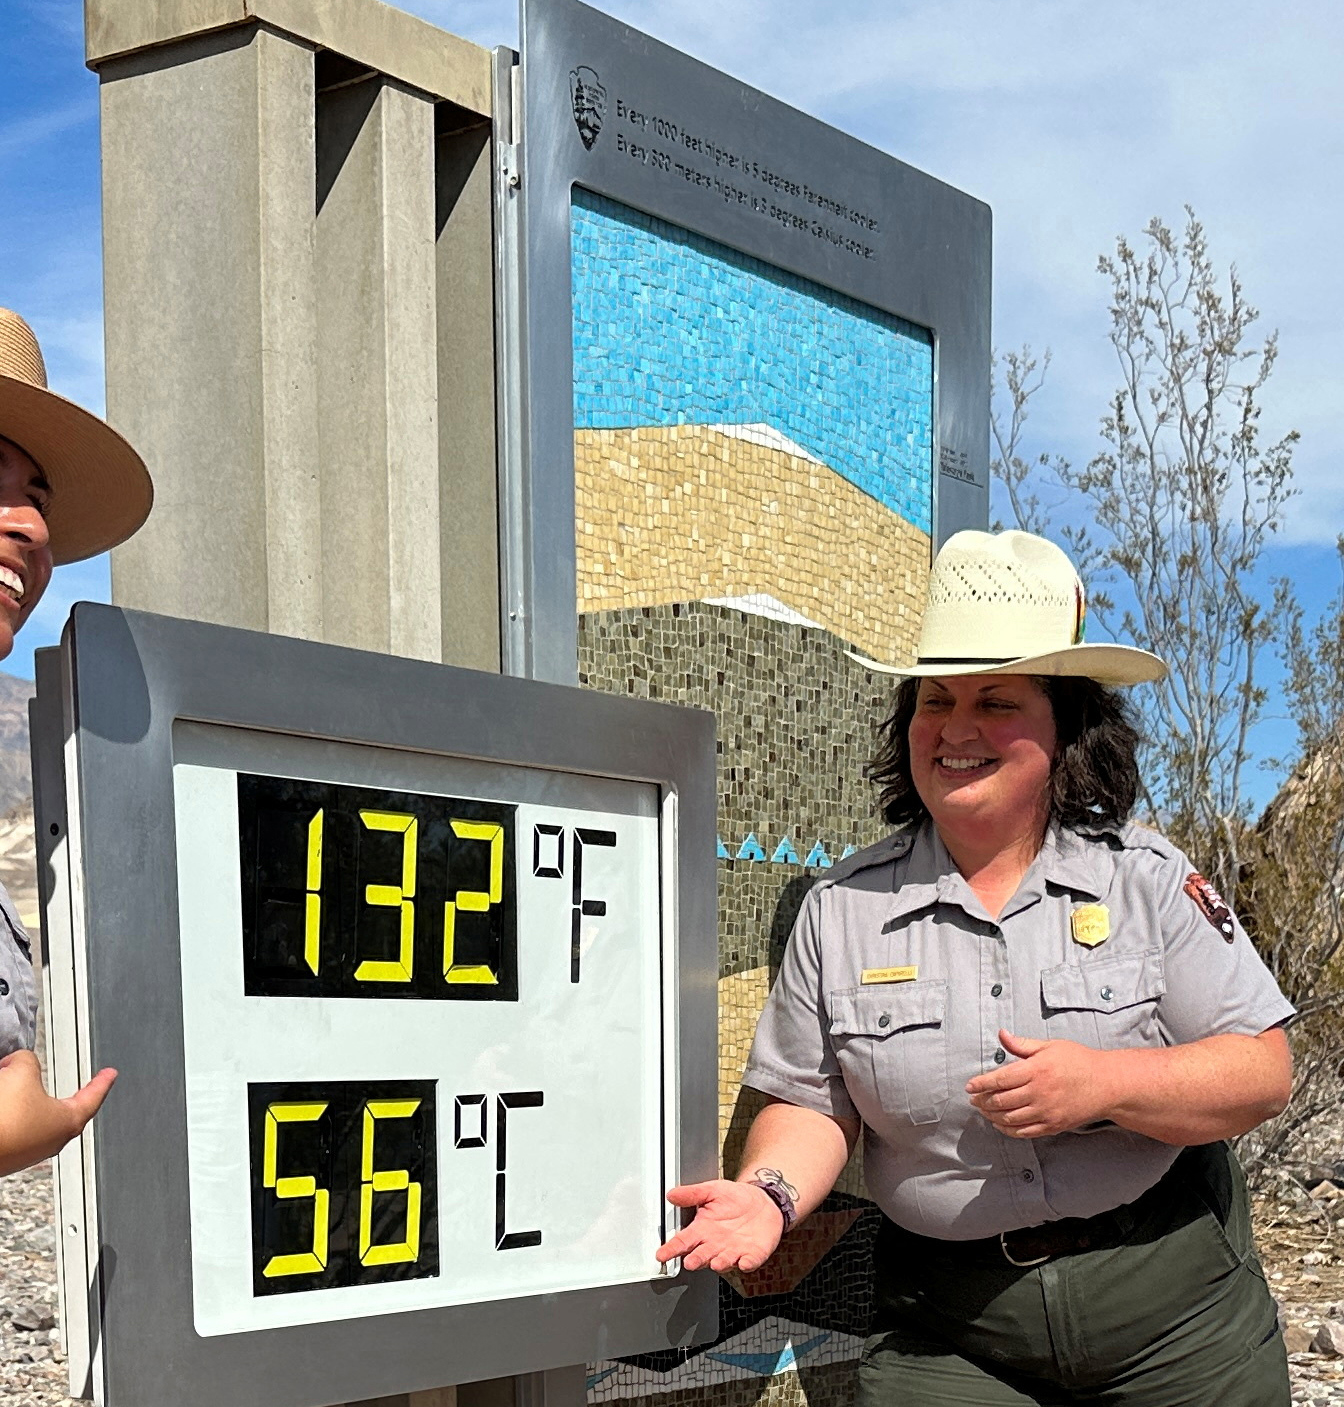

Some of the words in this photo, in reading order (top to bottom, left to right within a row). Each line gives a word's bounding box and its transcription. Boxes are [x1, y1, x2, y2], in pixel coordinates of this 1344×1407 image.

[617, 99, 648, 132] Every
[652, 116, 677, 142] 1000
[680, 128, 702, 153] feet
[705, 139, 739, 169] higher
[762, 166, 800, 197] degrees
[617, 133, 649, 166] Every
[675, 162, 711, 190] meters
[714, 175, 748, 205] higher
[770, 202, 808, 232] degrees
